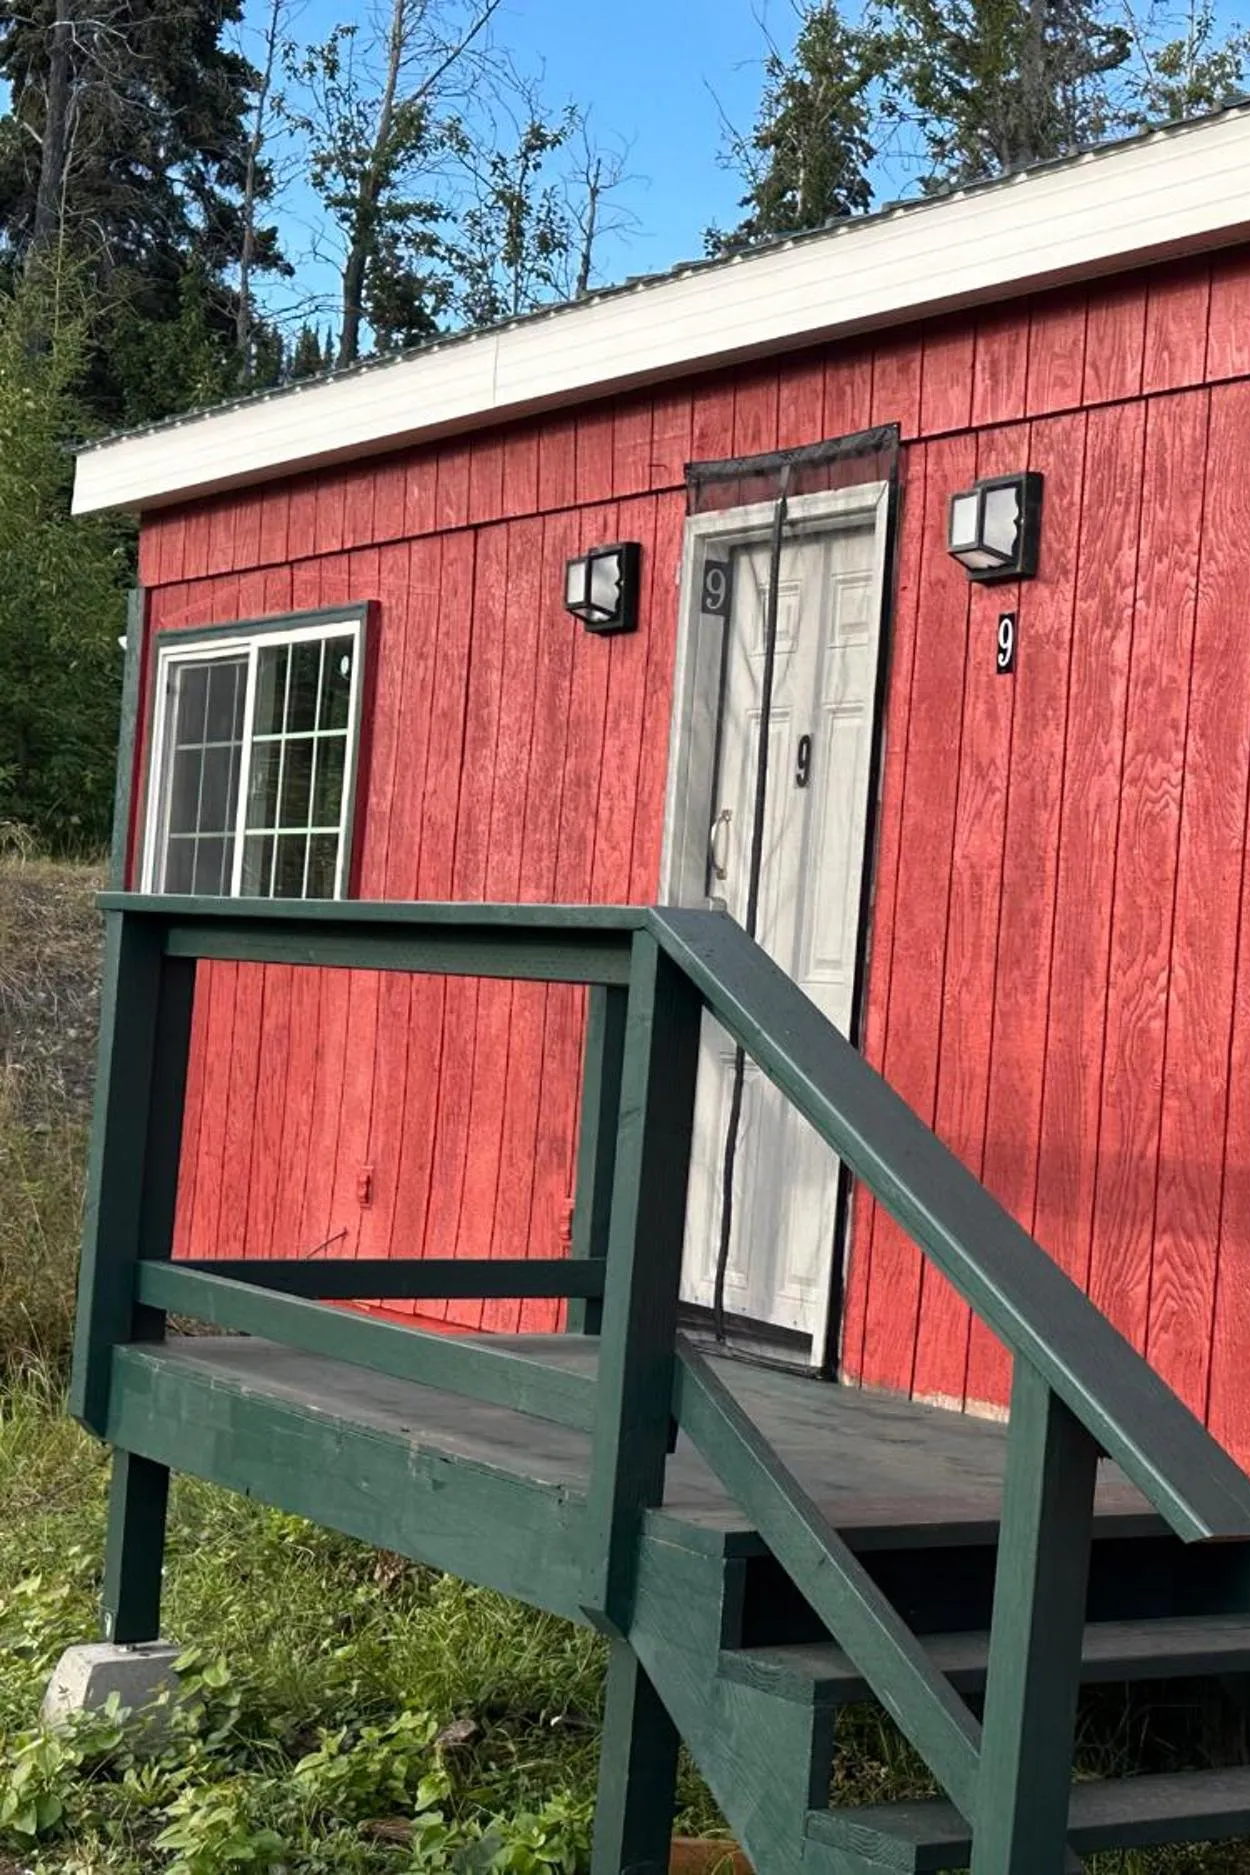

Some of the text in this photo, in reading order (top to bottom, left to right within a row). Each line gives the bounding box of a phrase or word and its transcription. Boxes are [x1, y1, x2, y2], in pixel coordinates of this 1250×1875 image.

[706, 568, 726, 610] 9
[997, 618, 1014, 667] 9
[796, 735, 812, 788] 9
